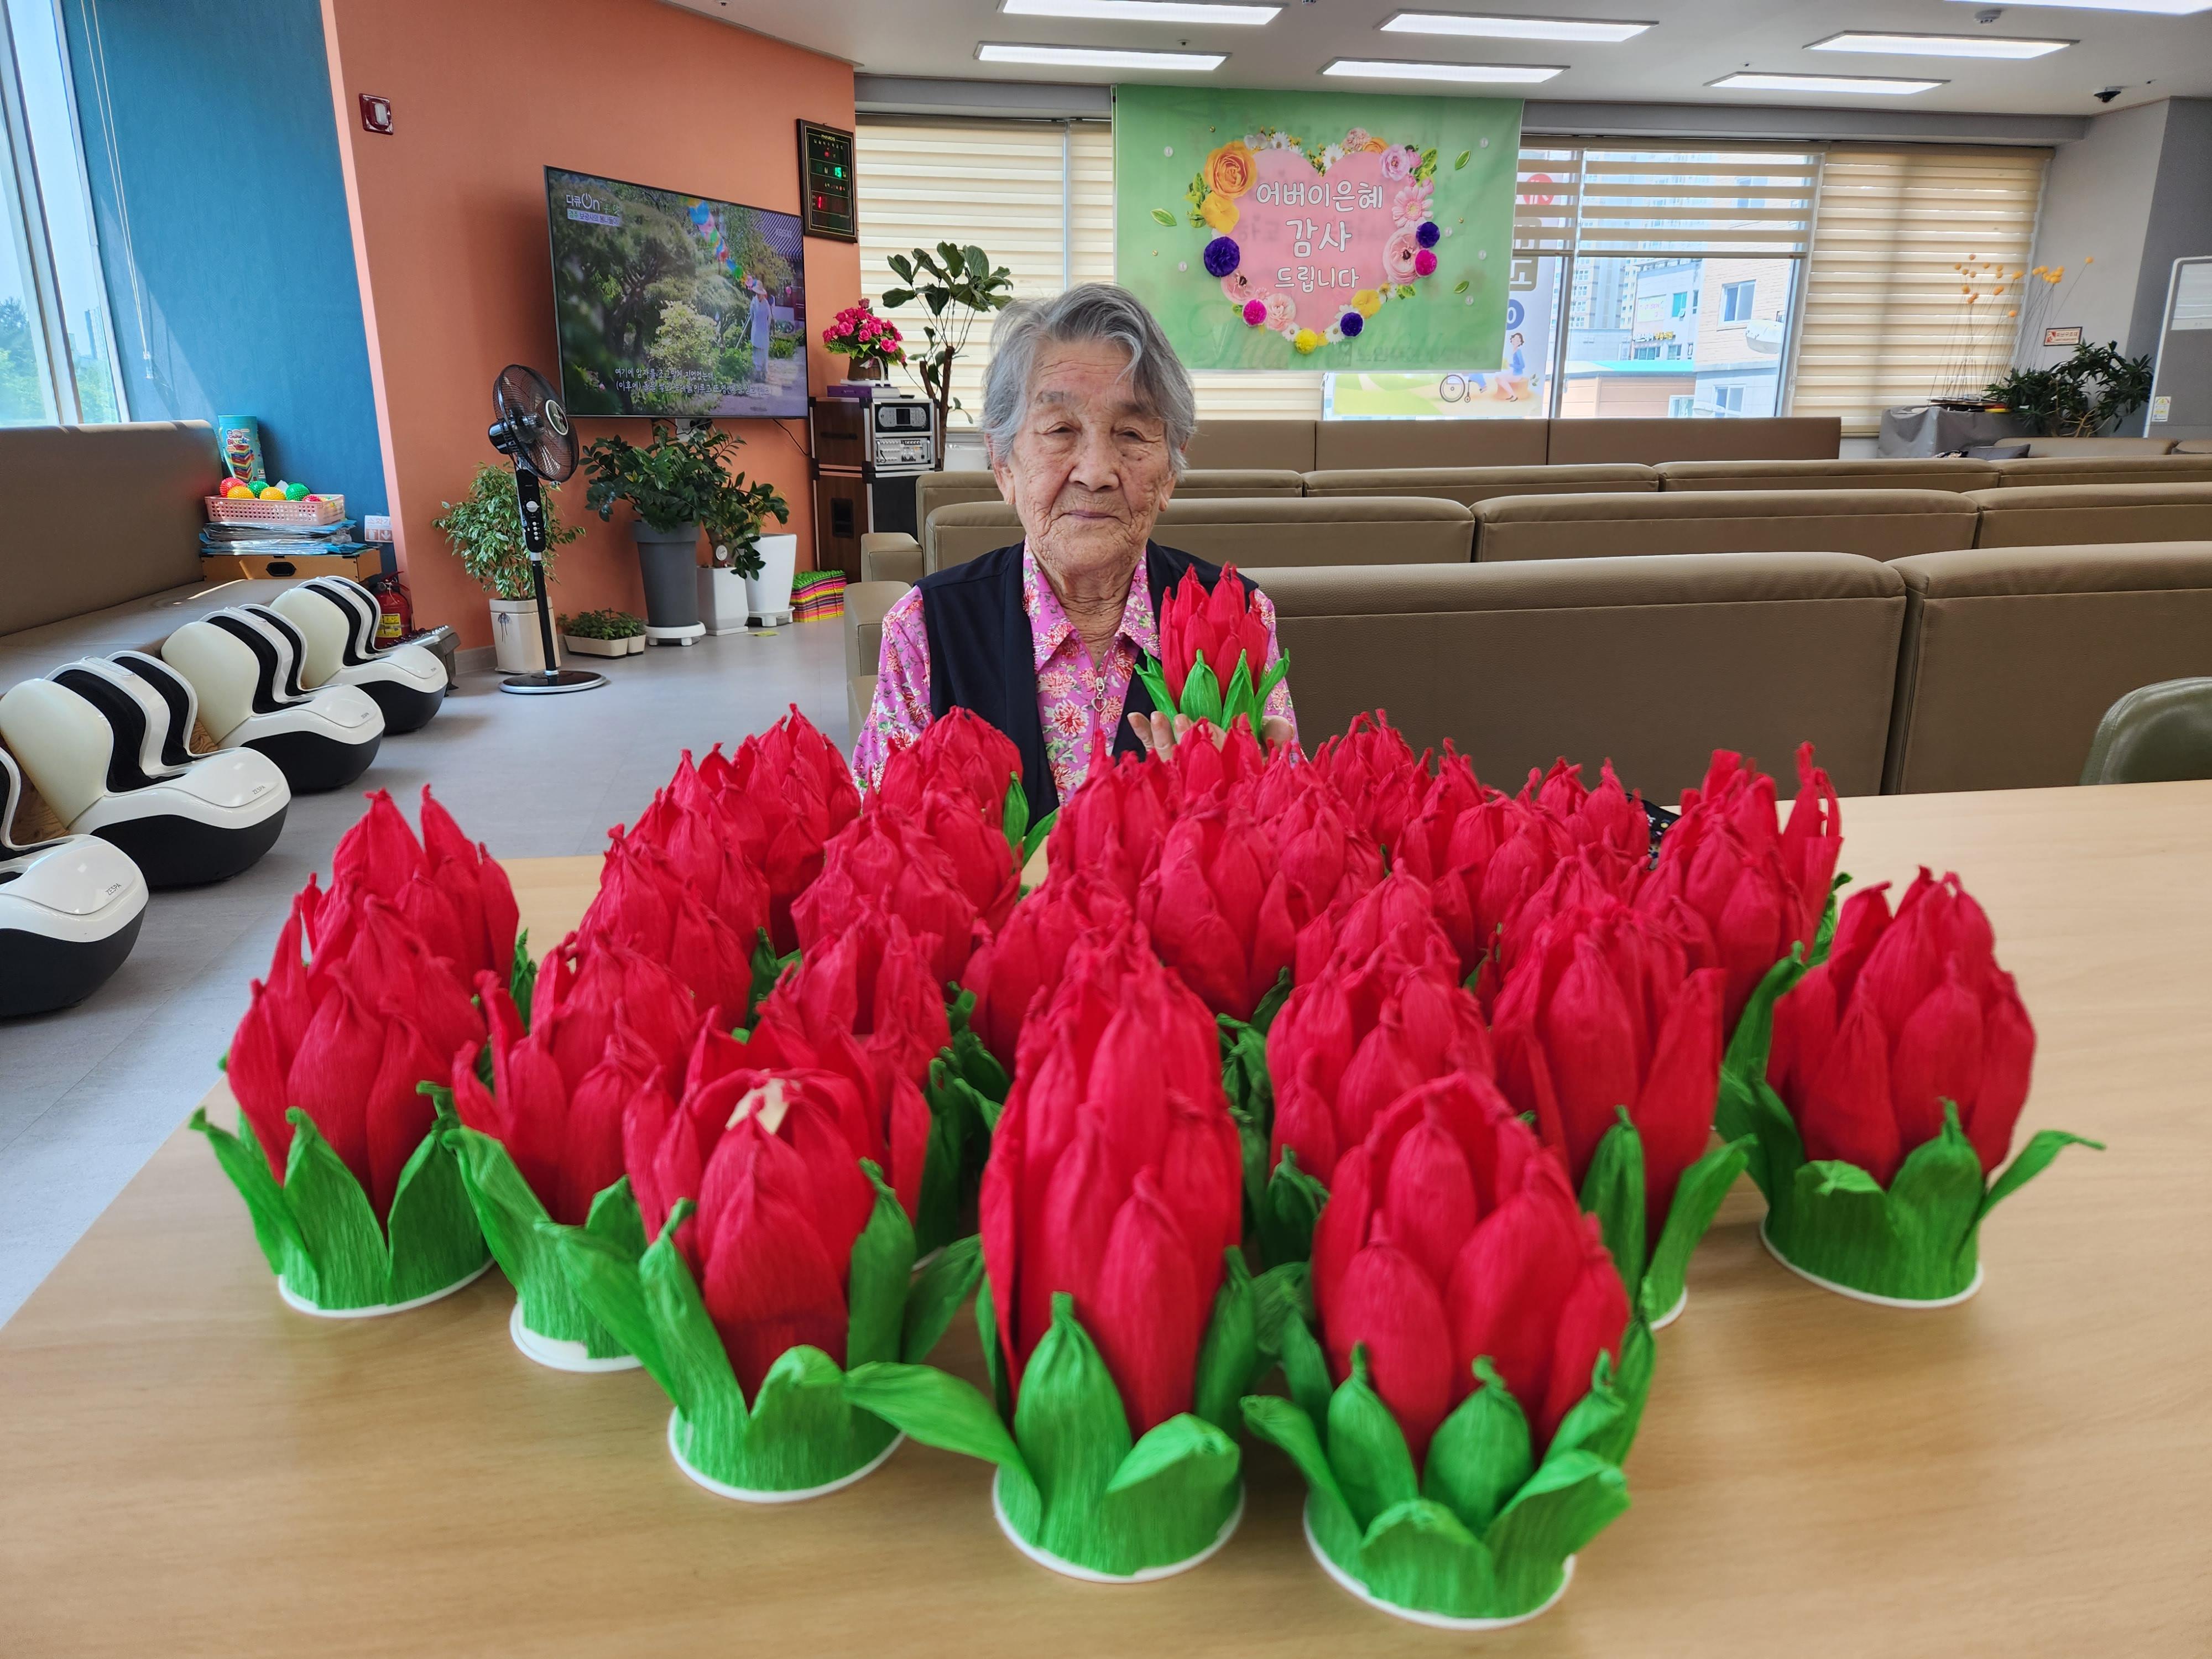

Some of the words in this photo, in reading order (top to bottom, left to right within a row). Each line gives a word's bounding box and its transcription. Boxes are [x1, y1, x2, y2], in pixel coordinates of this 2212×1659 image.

[1256, 180, 1383, 212] 어버이은혜
[1286, 218, 1352, 258] 감사
[1275, 265, 1359, 293] 드립니다
[615, 367, 634, 378] 여기에
[636, 368, 656, 379] 암자를
[685, 369, 713, 381] 지었었는데
[616, 381, 641, 392] (이후에)
[643, 381, 656, 393] 돌을
[252, 785, 266, 795] ZESPA
[105, 883, 122, 896] ZESPA
